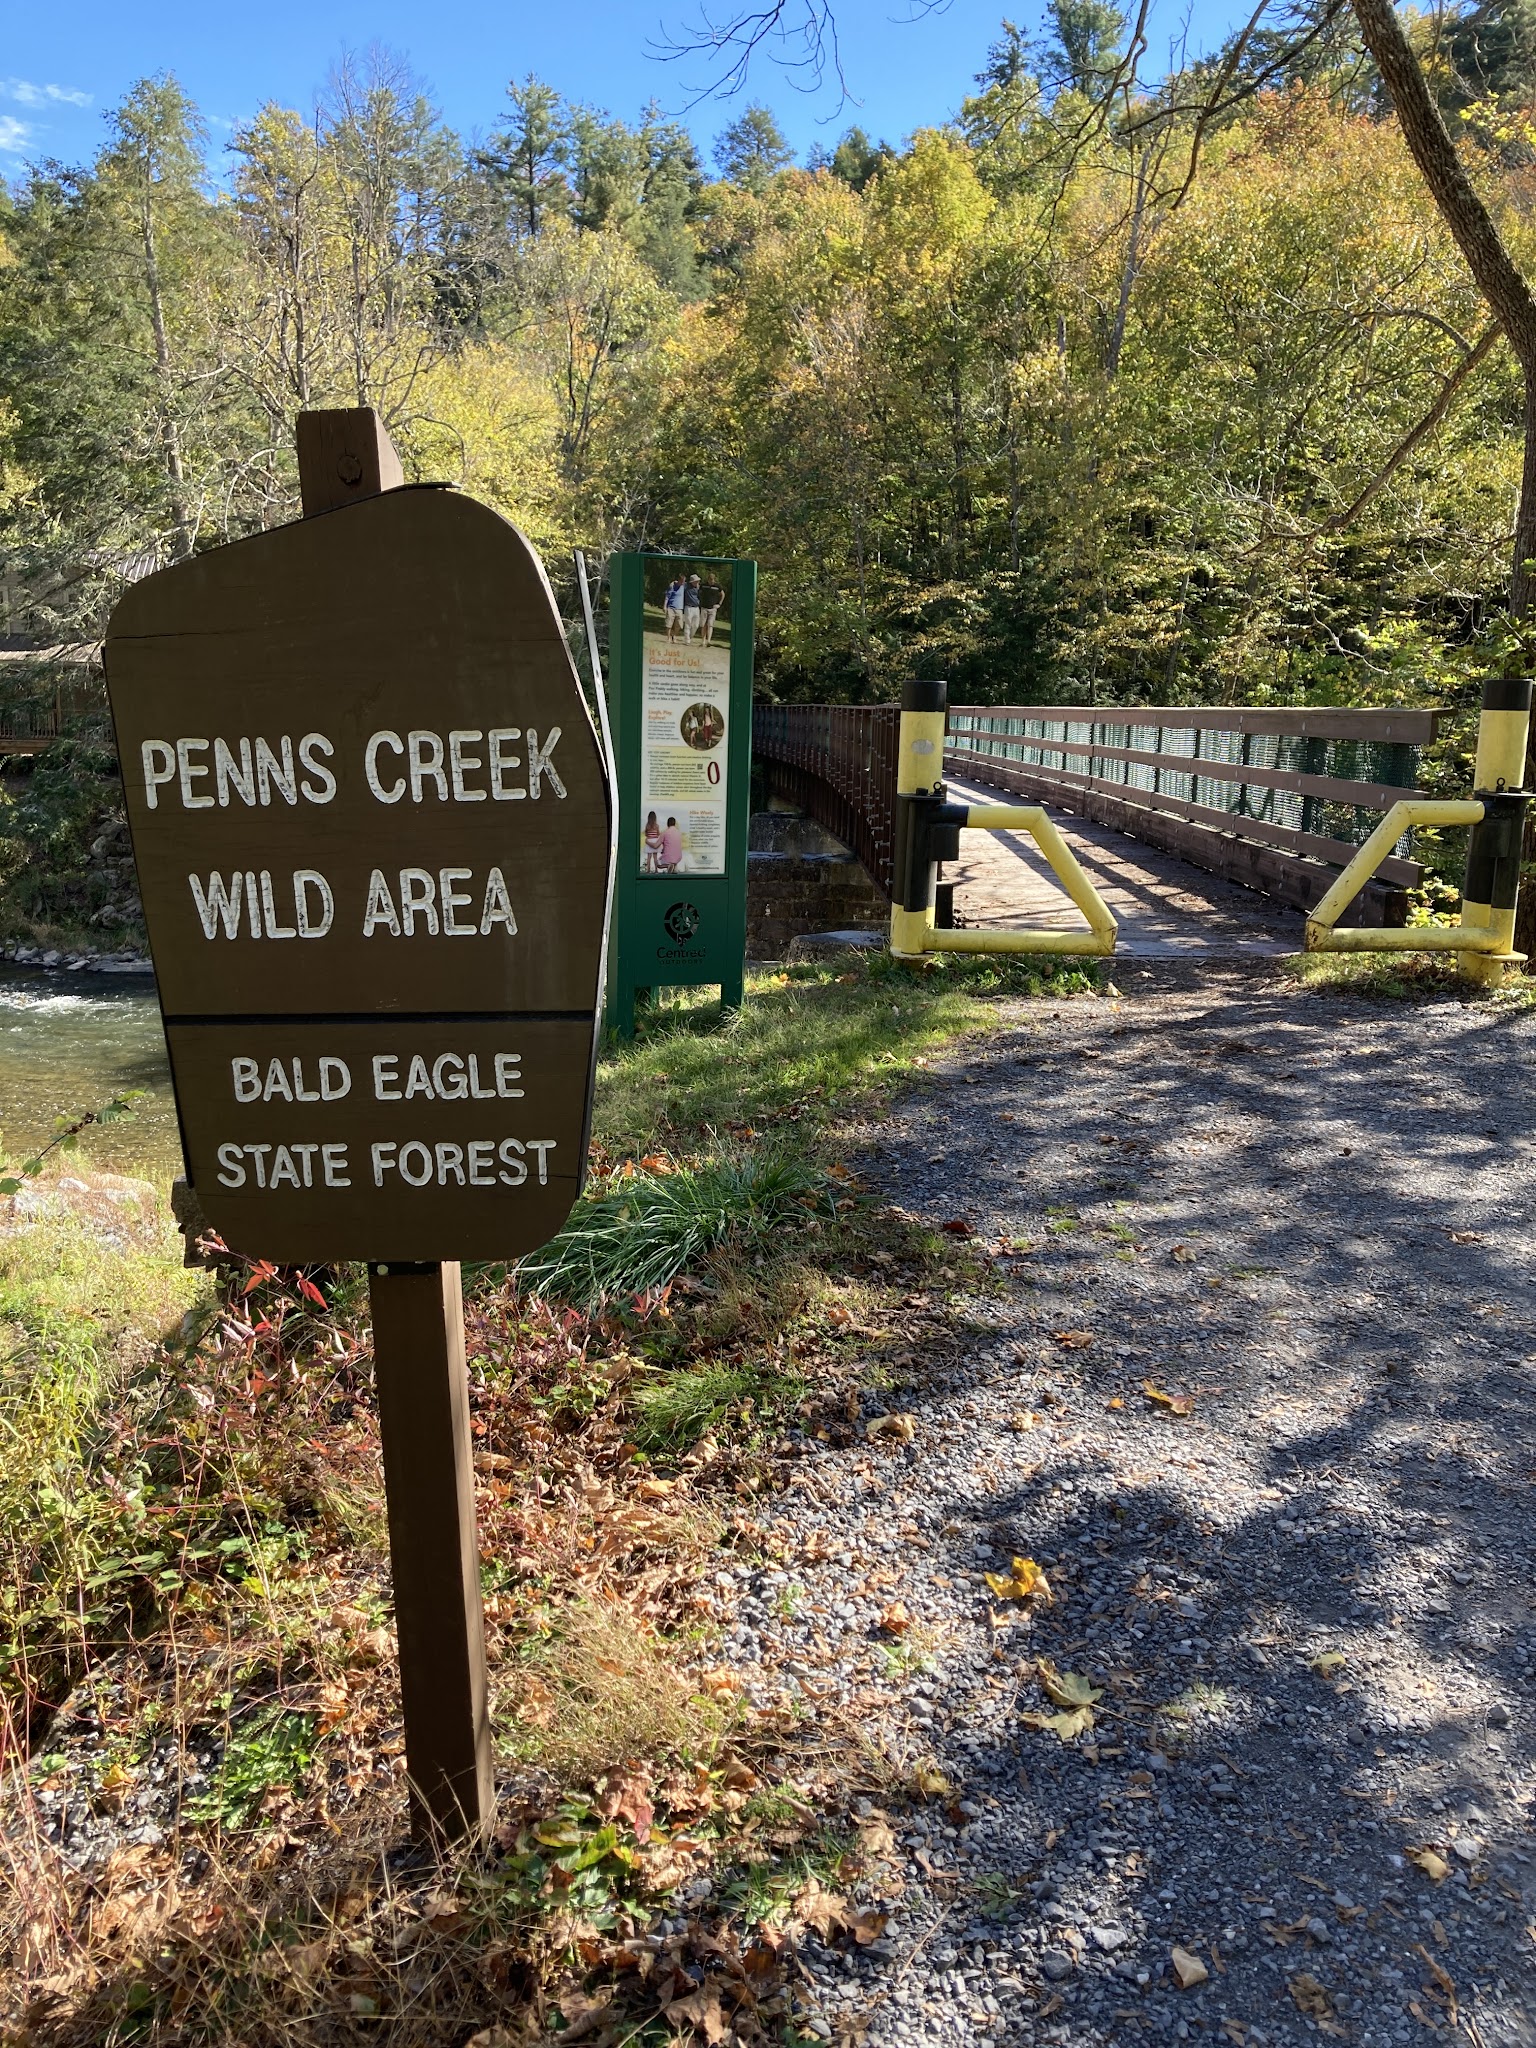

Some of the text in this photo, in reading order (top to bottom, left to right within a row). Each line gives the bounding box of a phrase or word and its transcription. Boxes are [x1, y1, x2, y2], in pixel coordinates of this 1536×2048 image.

[649, 657, 701, 667] Good for Us!
[664, 649, 681, 657] Just
[141, 727, 568, 809] PENNS CREEK
[189, 867, 518, 940] WILD AREA
[231, 1053, 525, 1102] BALD EAGLE
[217, 1138, 557, 1189] STATE FOREST
